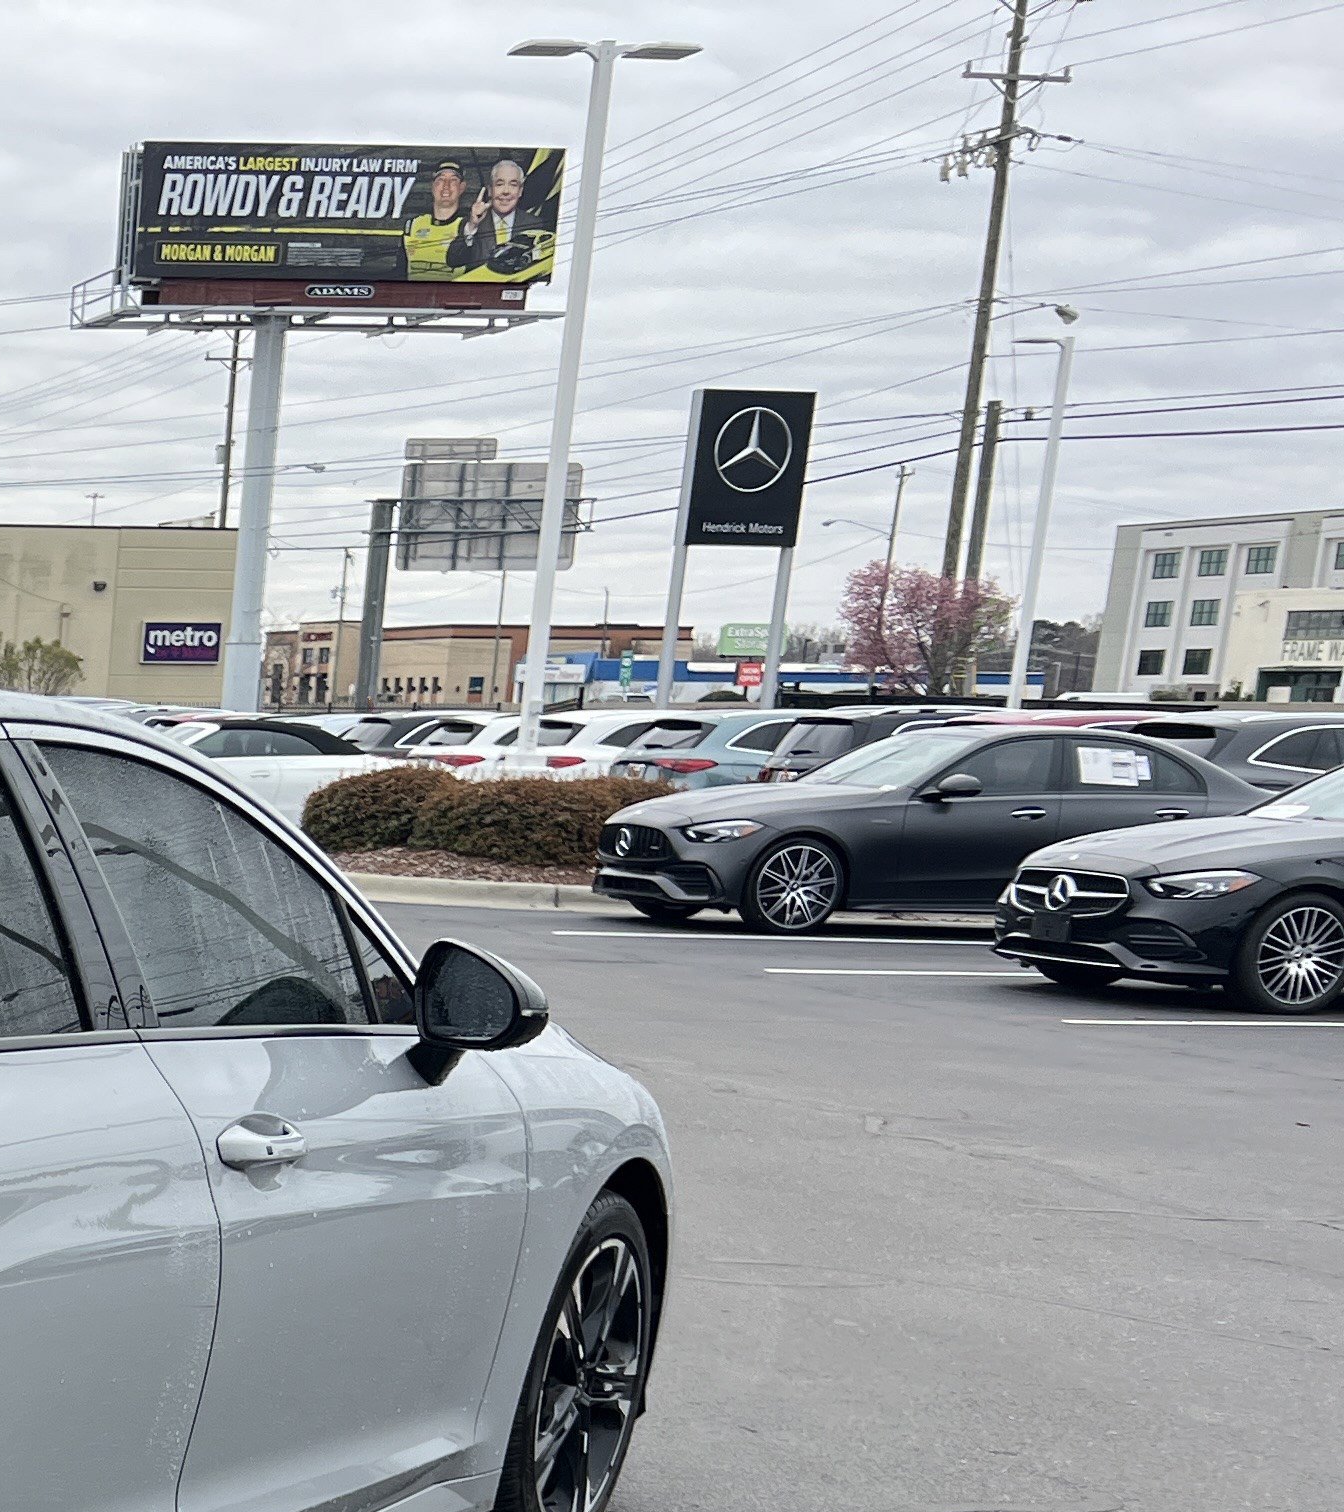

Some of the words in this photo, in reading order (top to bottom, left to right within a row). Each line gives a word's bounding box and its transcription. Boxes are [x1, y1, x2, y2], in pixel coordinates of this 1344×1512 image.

[163, 156, 237, 170] AMERICA'S
[239, 157, 299, 171] LARGEST
[301, 158, 350, 172] INJURY
[353, 159, 383, 172] LAW
[384, 160, 419, 173] FIRM
[158, 173, 279, 217] ROWDY
[277, 175, 305, 218] &
[306, 176, 416, 219] READY
[161, 244, 212, 261] MORGAN
[213, 244, 223, 261] &
[225, 245, 277, 262] MORGAN
[310, 287, 369, 296] ADAMS
[702, 521, 747, 533] Hendrick
[748, 522, 784, 535] Motors
[148, 626, 218, 648] metro
[1280, 641, 1324, 661] FRAME
